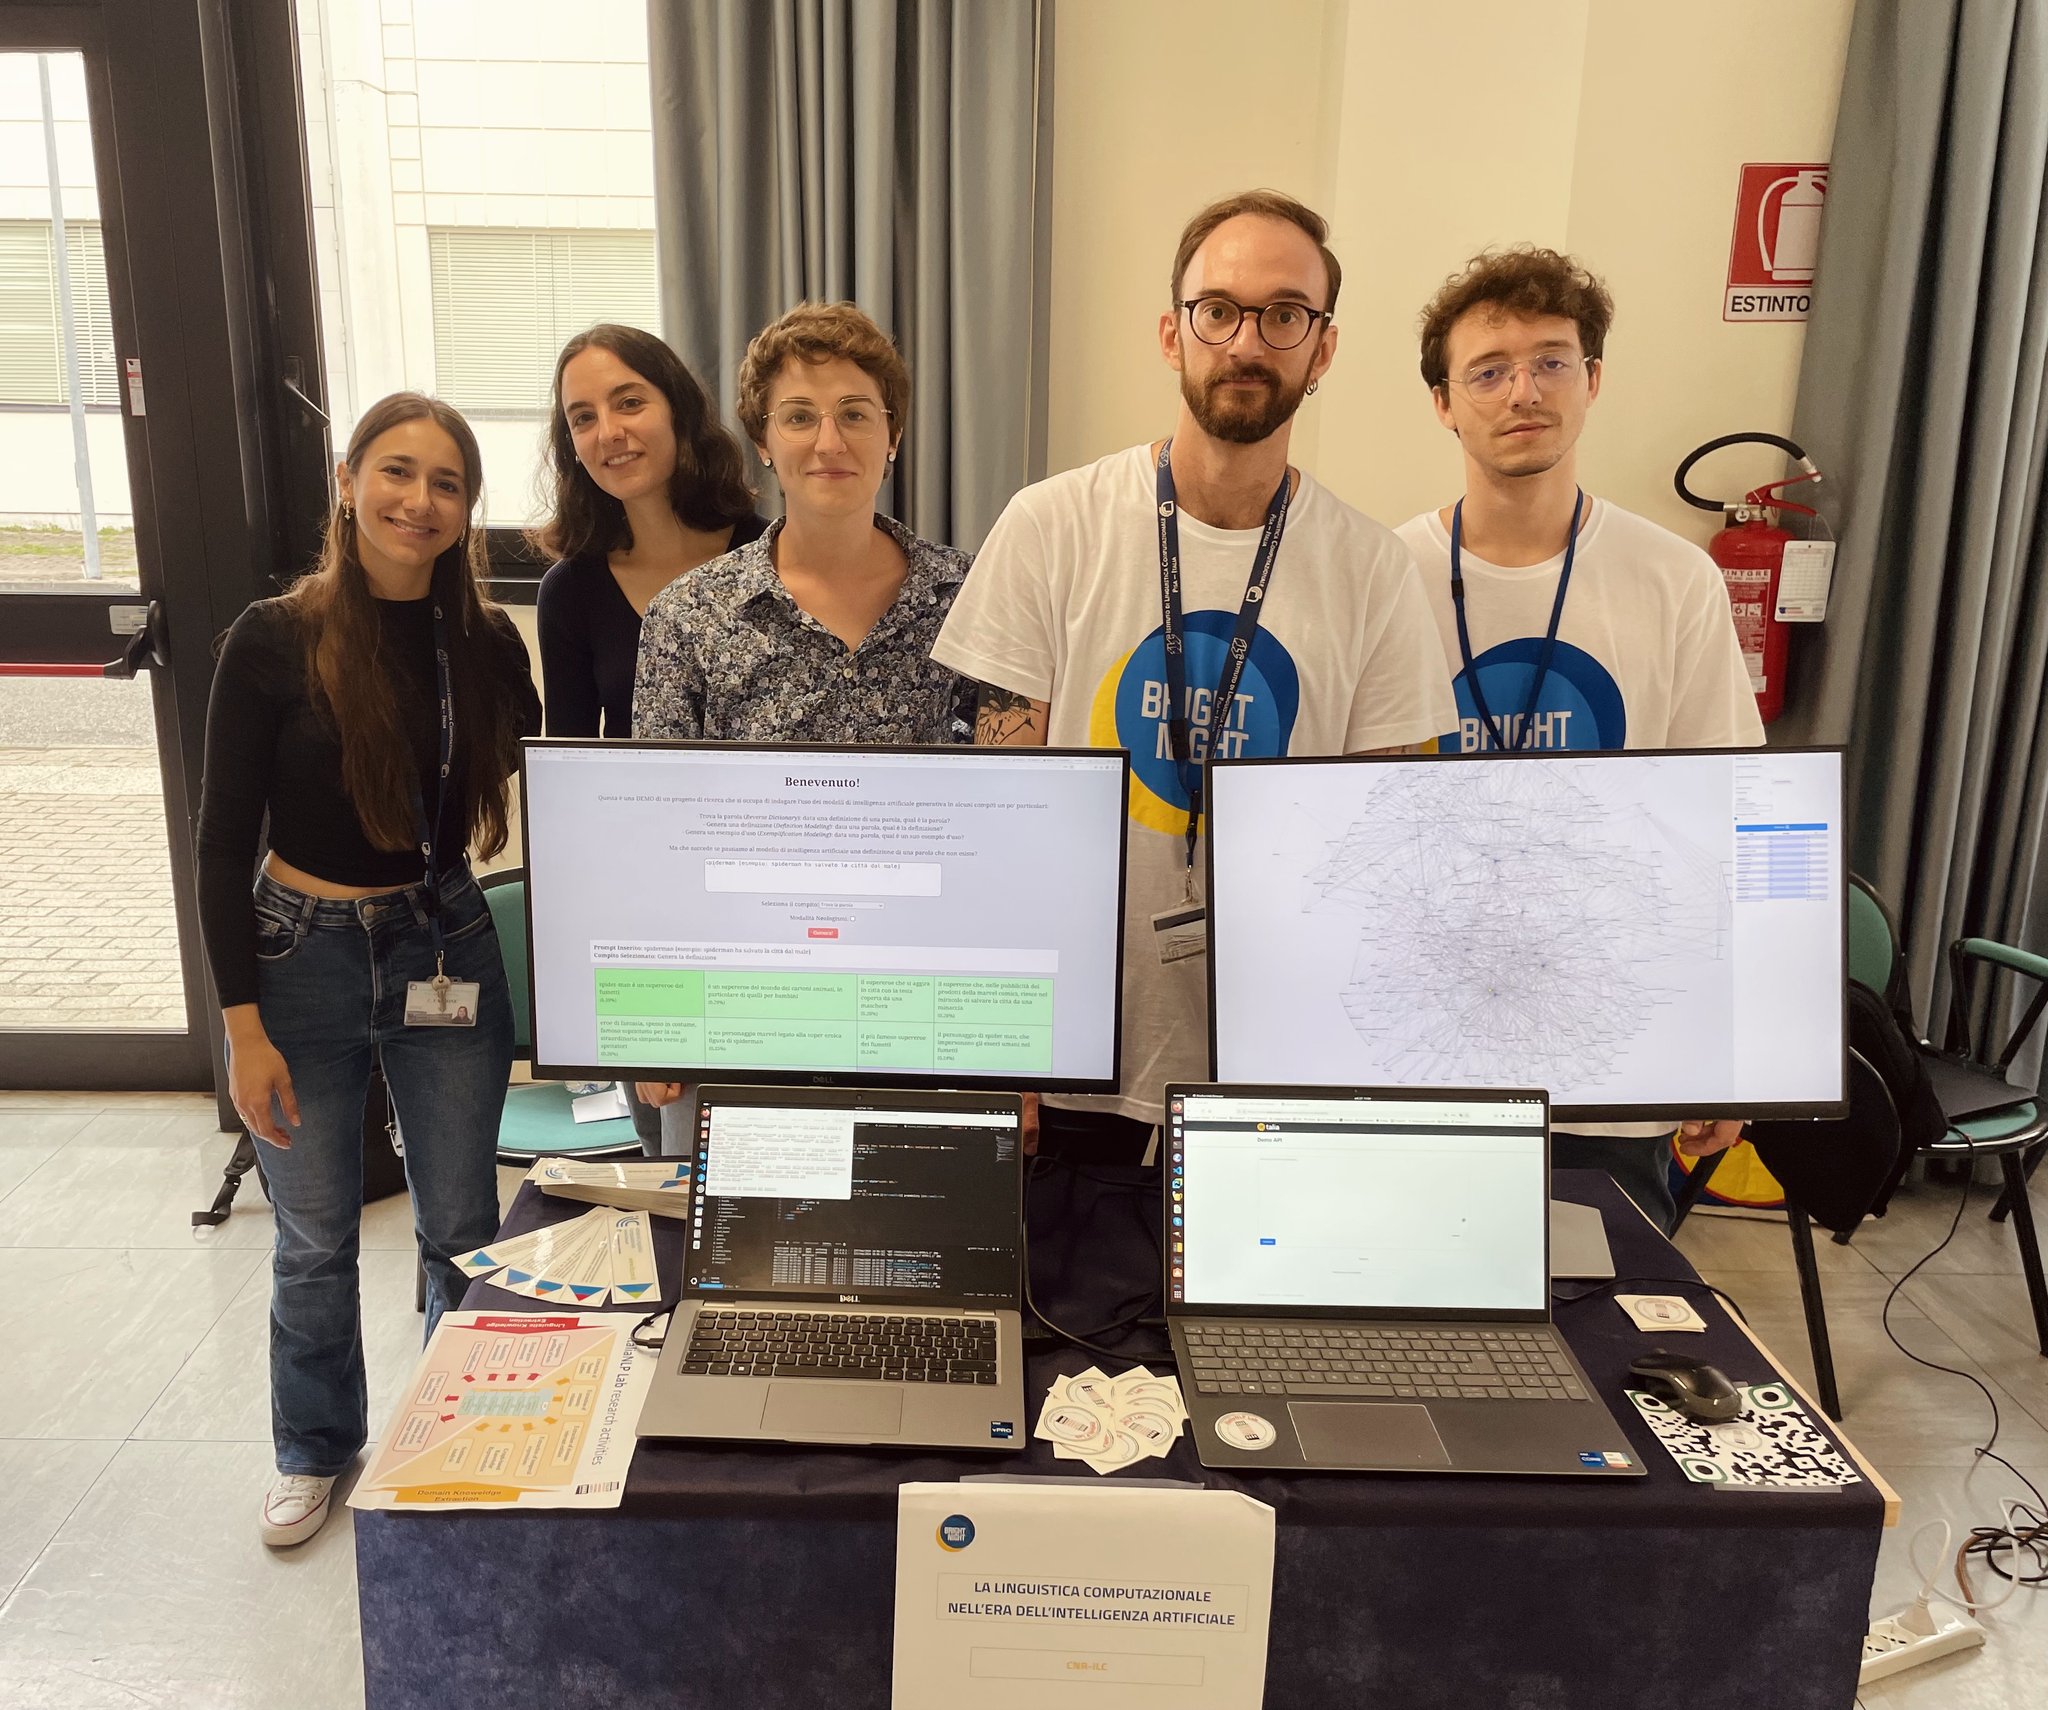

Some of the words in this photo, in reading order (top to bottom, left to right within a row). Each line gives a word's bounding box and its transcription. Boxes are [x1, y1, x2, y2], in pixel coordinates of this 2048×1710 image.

[1156, 722, 1249, 765] NGHT
[785, 776, 860, 788] Benevenuto!
[723, 813, 742, 821] parola
[881, 816, 902, 824] parola,
[902, 816, 916, 824] qual
[928, 816, 950, 825] parola?
[773, 822, 803, 830] (Definition
[860, 823, 881, 832] parola,
[881, 824, 895, 832] qual
[720, 845, 748, 854] passiamo
[786, 846, 820, 855] intelligenza
[914, 849, 933, 857] parola
[840, 1294, 860, 1302] DELL
[620, 1337, 638, 1372] taliaNLP
[614, 1374, 629, 1388] Lab
[604, 1390, 622, 1426] research
[592, 1428, 612, 1466] activities
[974, 1582, 990, 1592] LA
[994, 1582, 1080, 1597] LINGUISTICA
[1084, 1586, 1211, 1602] COMPUTAZIONALE
[948, 1603, 1012, 1616] NELL'ERA
[1016, 1606, 1149, 1622] DELL'INTELLIGENZA
[1152, 1612, 1235, 1625] ARTIFICIALE
